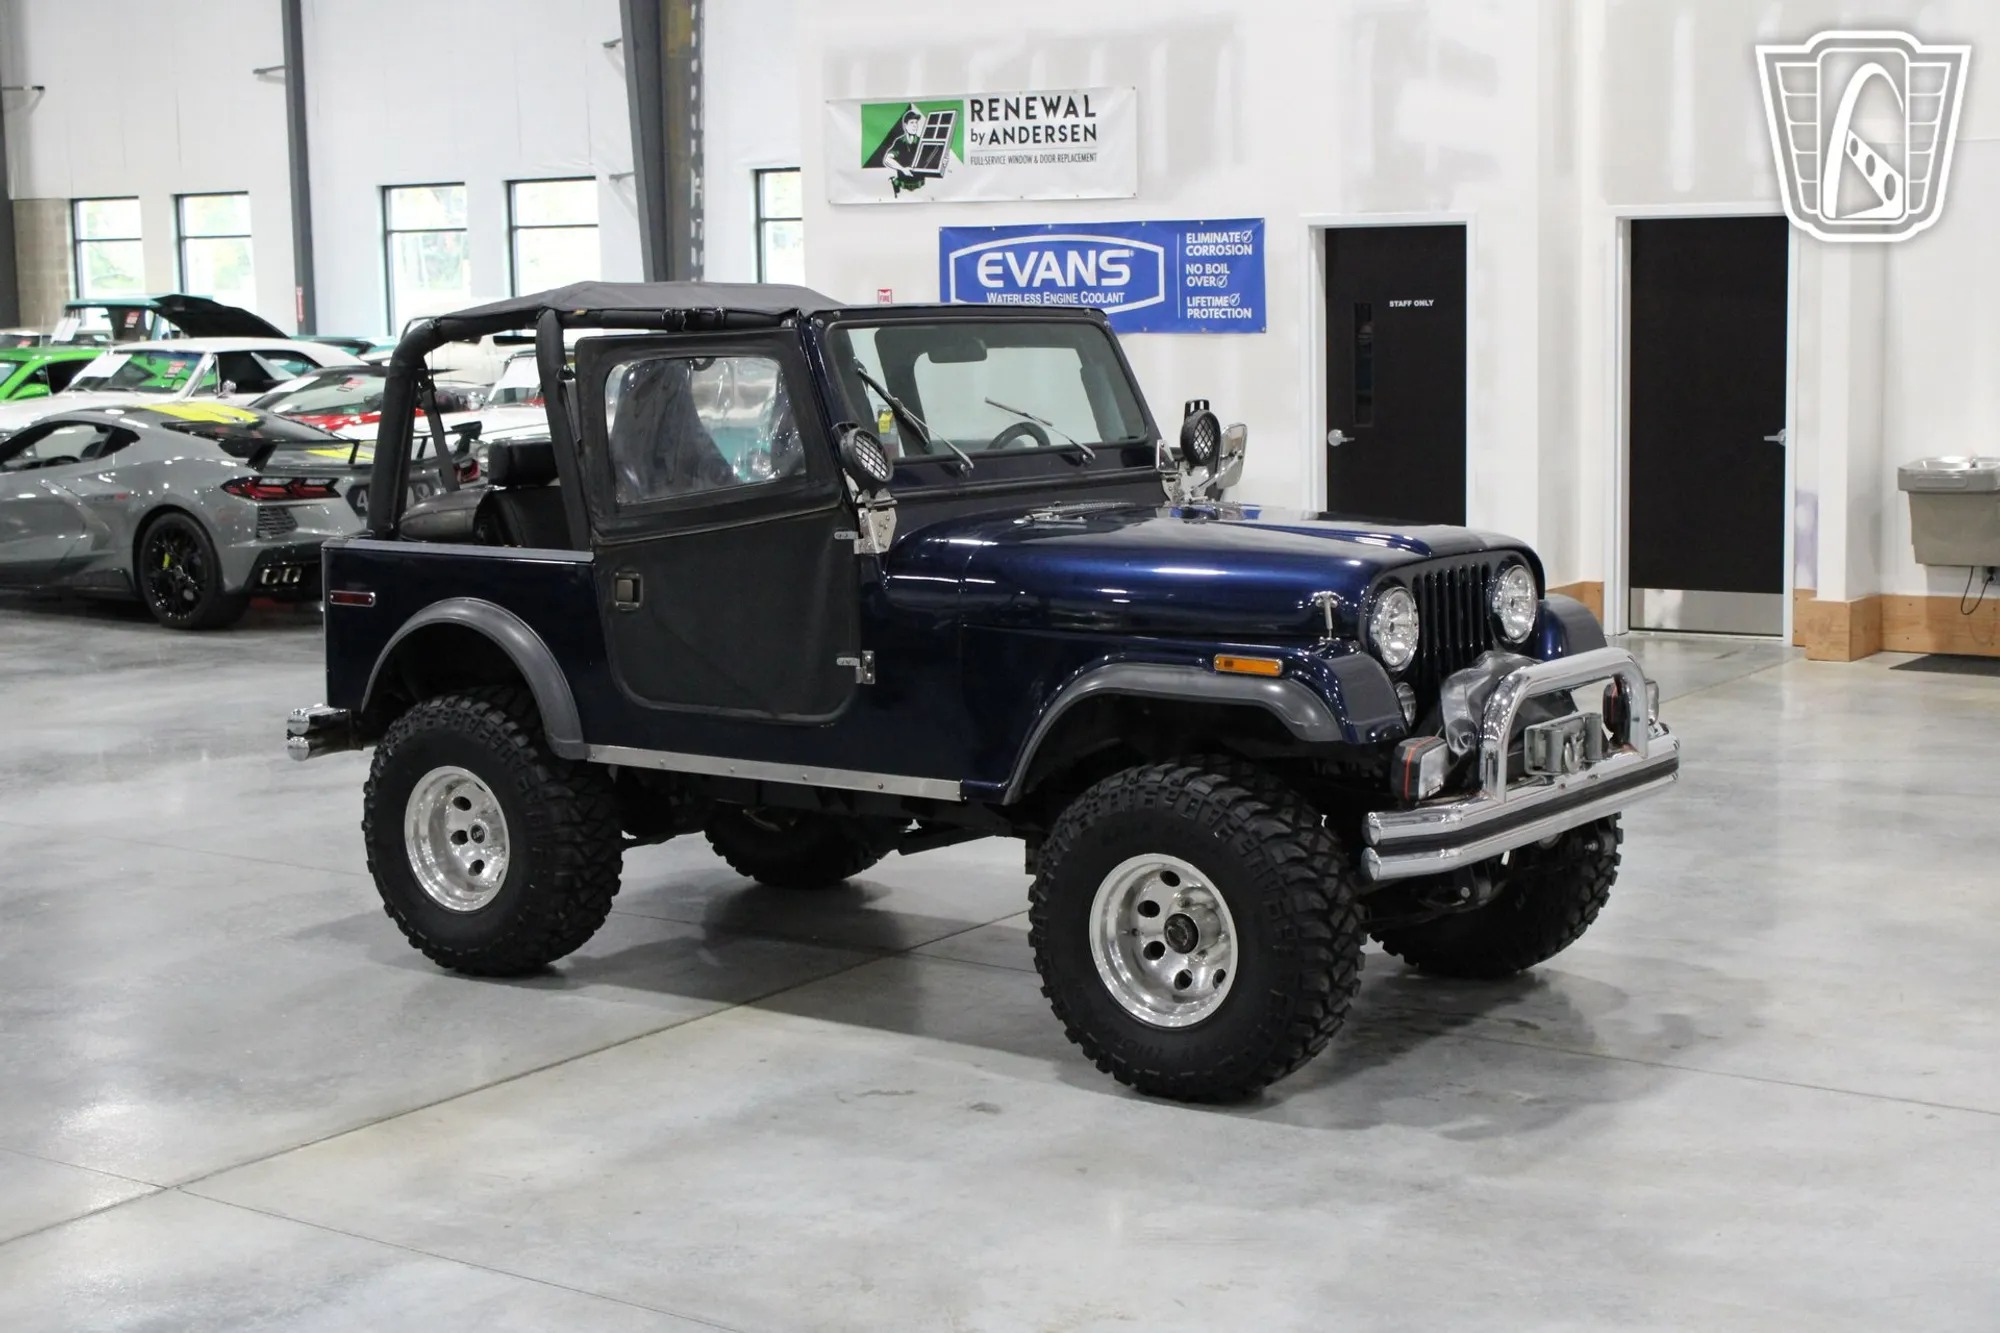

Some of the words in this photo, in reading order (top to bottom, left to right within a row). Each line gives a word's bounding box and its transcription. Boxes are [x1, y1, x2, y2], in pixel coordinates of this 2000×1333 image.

[970, 94, 1096, 122] RENEWAL
[970, 128, 986, 145] by
[988, 123, 1097, 145] ANDERSEN
[1008, 154, 1033, 165] WINDOW
[1034, 154, 1039, 164] &
[1040, 153, 1056, 164] DOOR
[1057, 152, 1097, 163] REPLACEMENT
[1186, 232, 1241, 244] ELIMINATE
[1186, 244, 1253, 256] CORROSION
[977, 249, 1131, 288] EVANS
[1186, 263, 1203, 275] NO
[1205, 263, 1230, 275] BOIL
[1186, 275, 1217, 287] OVER
[986, 292, 1041, 304] WATERLESS
[1043, 291, 1078, 304] ENGINE
[1080, 290, 1125, 304] COOLANT
[1186, 296, 1229, 307] LIFETIME
[1389, 300, 1412, 308] STAFF
[1413, 299, 1434, 307] ONLY
[1187, 307, 1252, 319] PROTECTION
